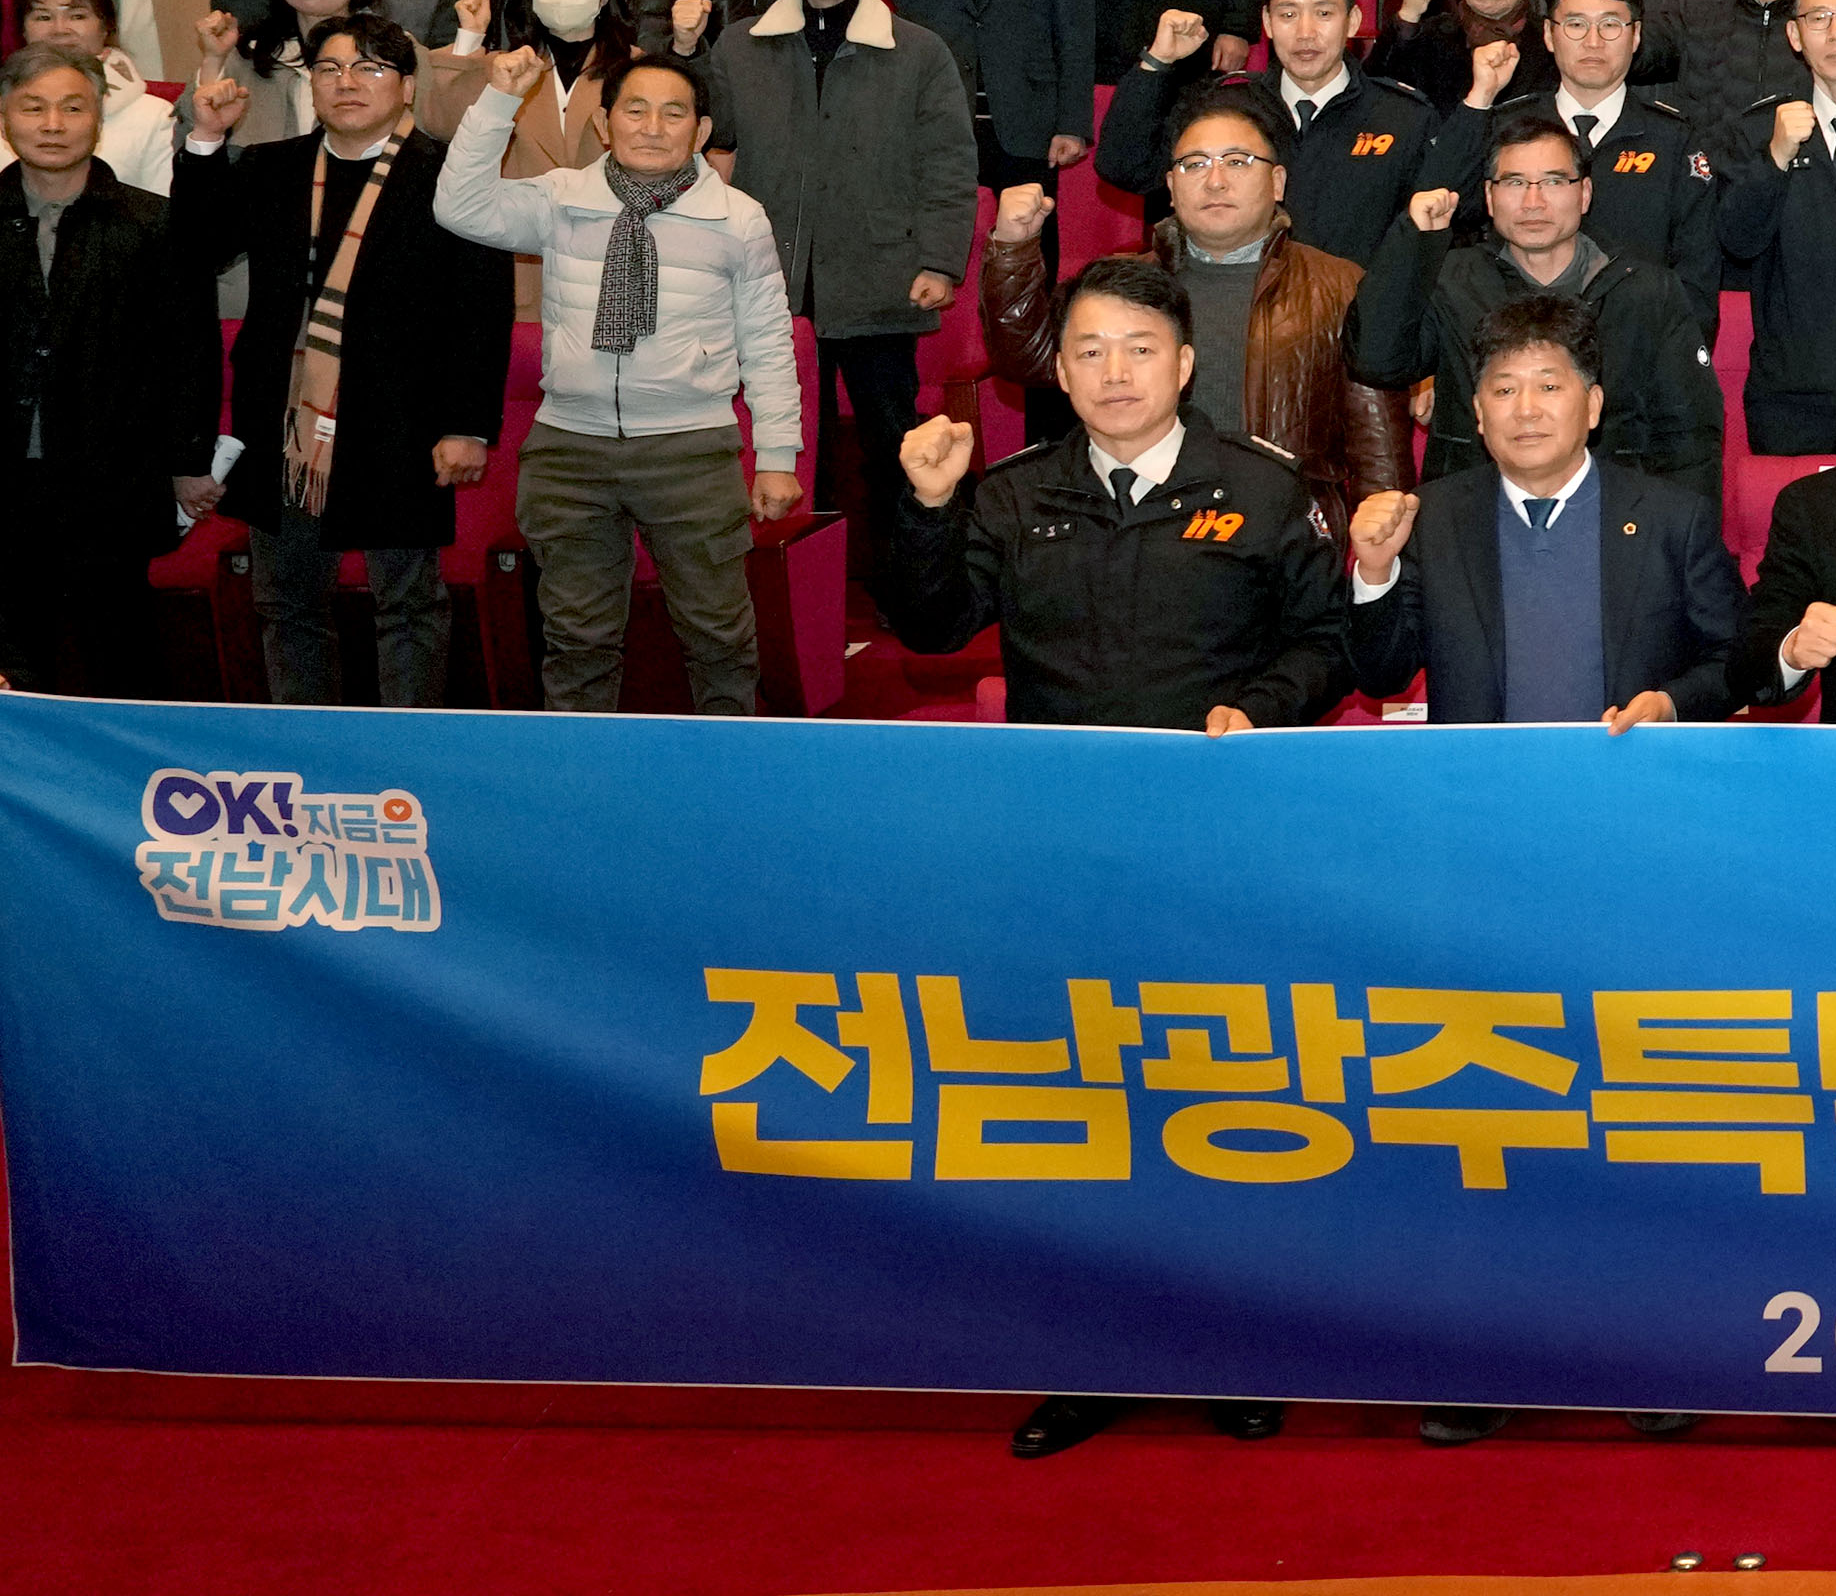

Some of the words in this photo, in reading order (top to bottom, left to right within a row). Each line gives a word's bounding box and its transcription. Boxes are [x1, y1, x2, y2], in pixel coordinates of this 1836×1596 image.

[1351, 134, 1394, 155] 119
[1613, 152, 1656, 172] 119
[1182, 513, 1244, 542] 119
[153, 776, 299, 838] OK!
[301, 798, 417, 844] 지금은
[146, 850, 431, 921] 전남시대
